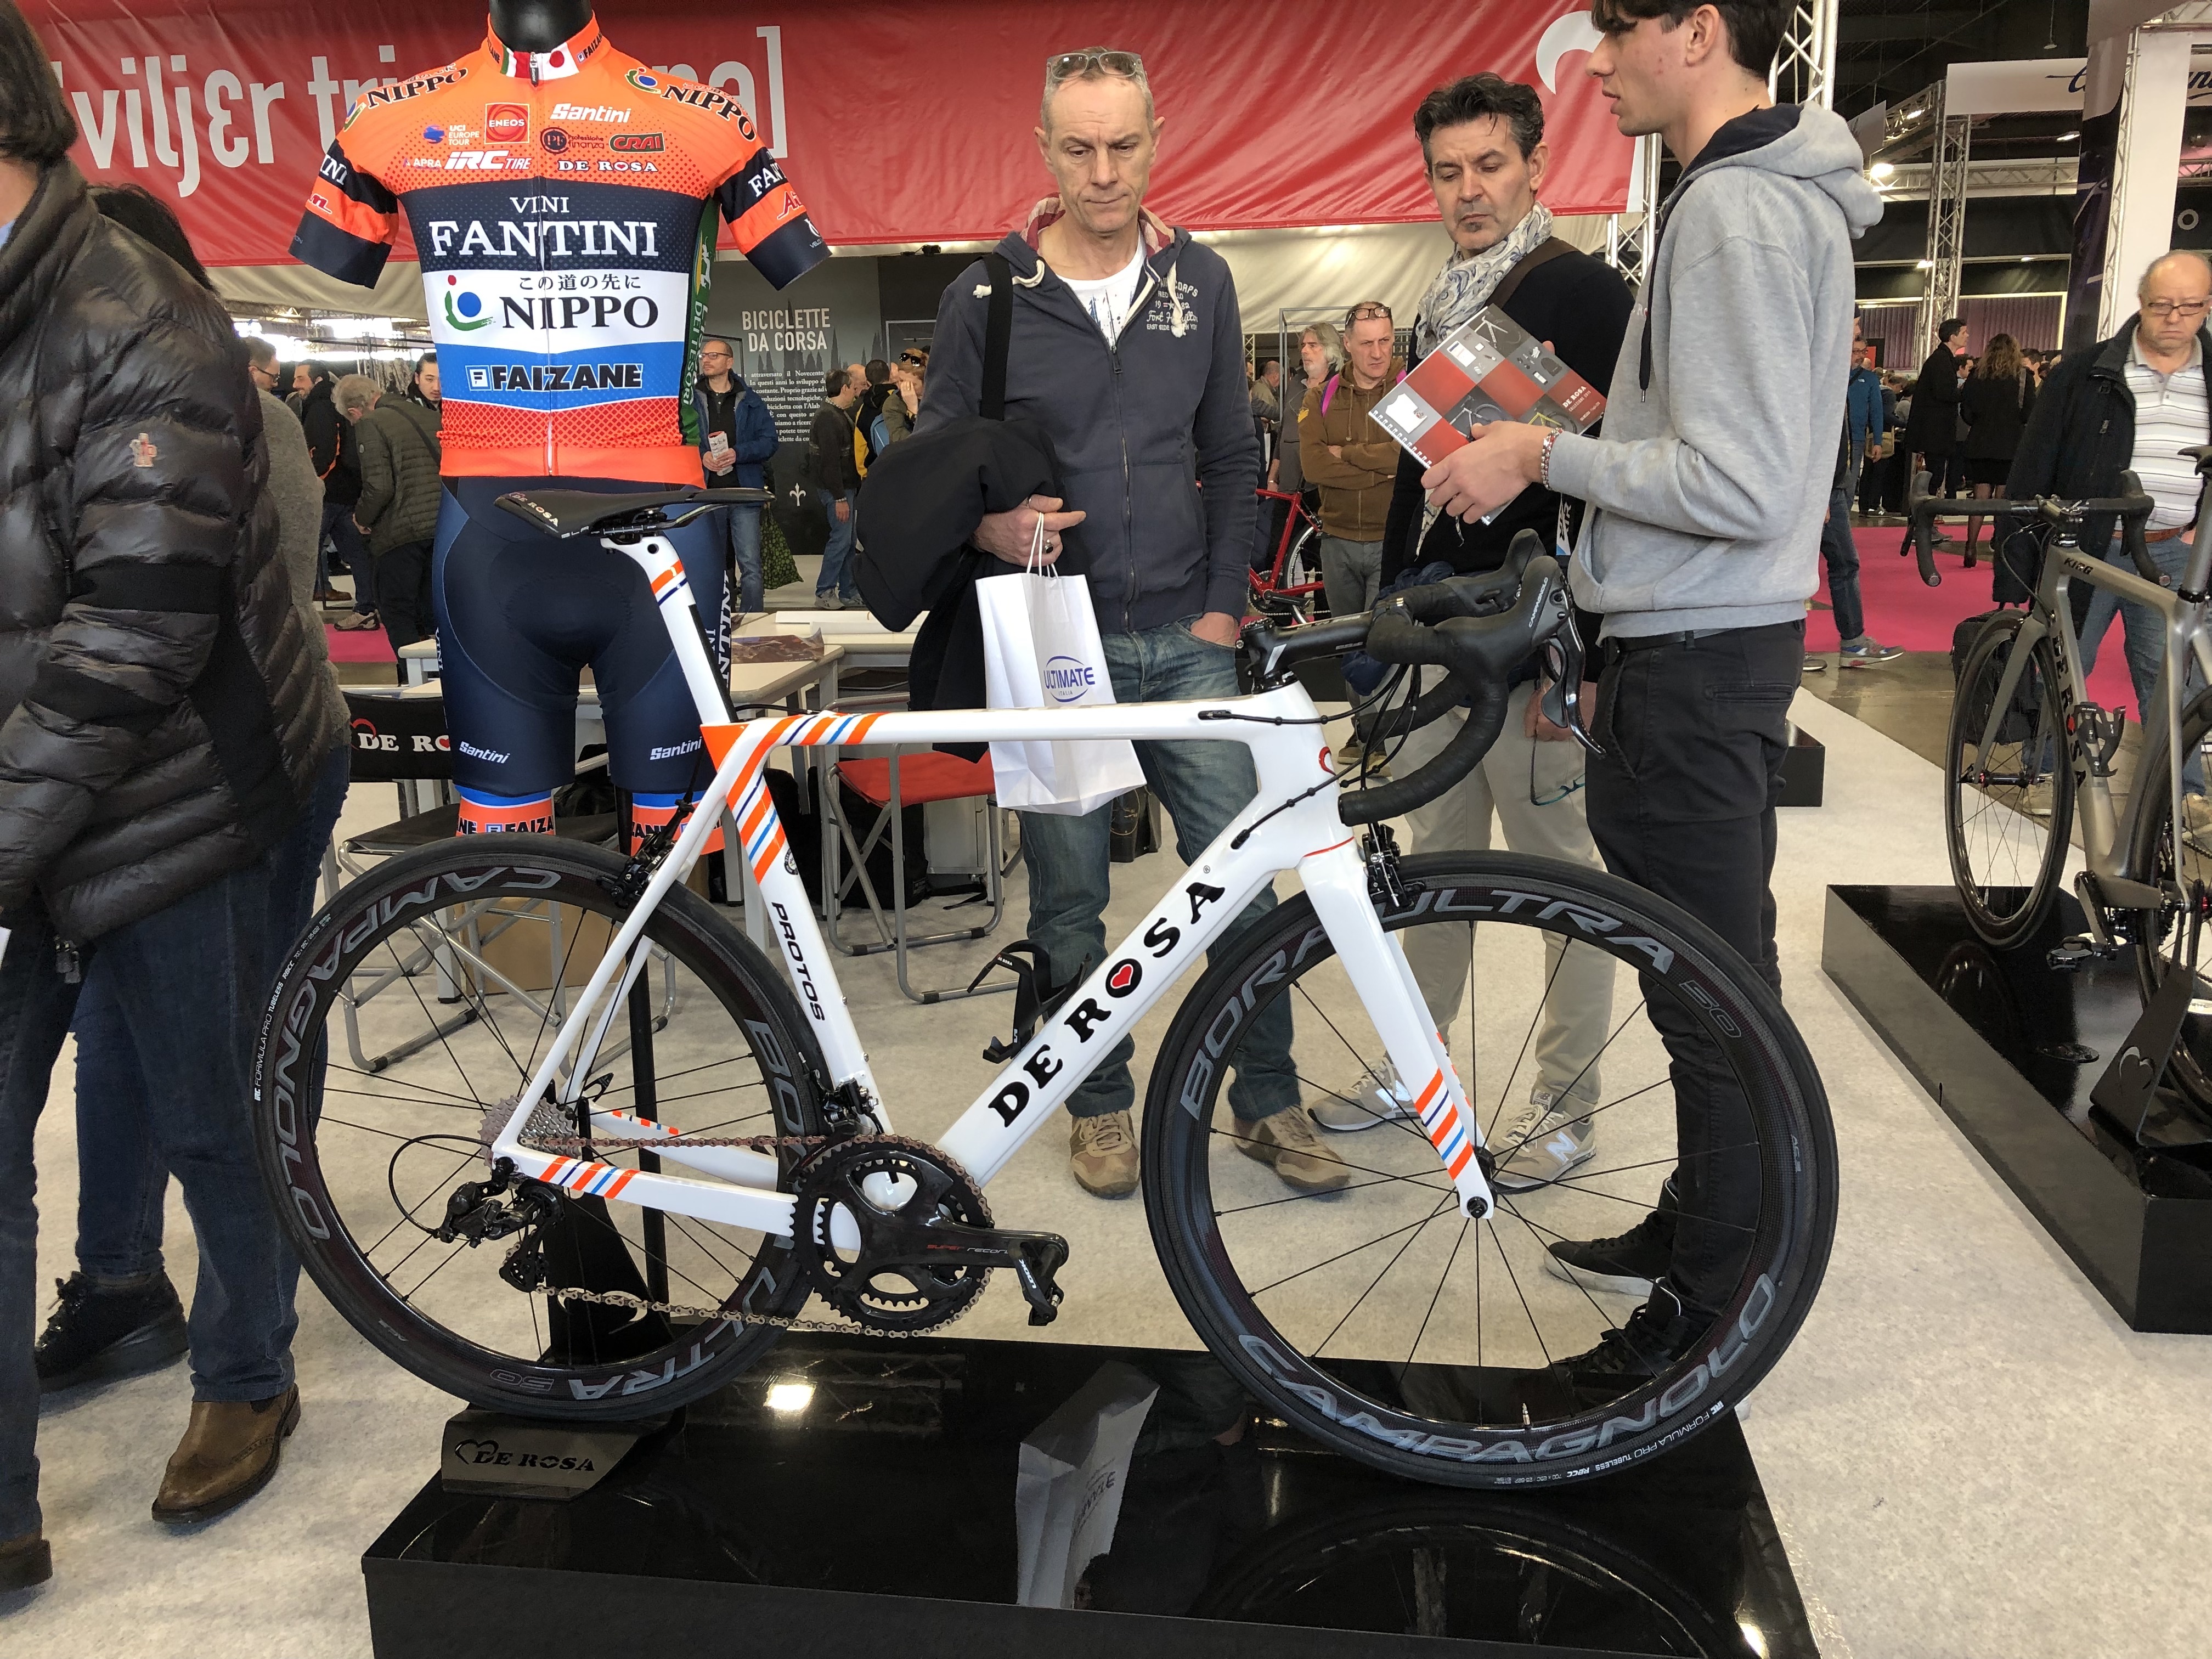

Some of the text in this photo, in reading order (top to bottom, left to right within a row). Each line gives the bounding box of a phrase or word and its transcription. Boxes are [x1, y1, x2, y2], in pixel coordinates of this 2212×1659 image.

[368, 67, 468, 109] NIPPO
[489, 119, 525, 127] ENEOS
[550, 103, 631, 123] Santini
[661, 84, 757, 142] NIPPO
[613, 136, 661, 150] CRAI
[413, 158, 442, 168] APRA
[505, 158, 532, 170] TIRE
[558, 160, 659, 172] DE ROSA
[510, 195, 569, 213] VINI
[429, 220, 659, 257] FANTINI
[519, 273, 642, 291] この道の先に
[499, 296, 659, 330] NIPPO
[1155, 300, 1161, 309] 19
[742, 308, 831, 330] BICICLETTE
[748, 330, 827, 352] DA CORSA
[683, 301, 703, 405] DEI TESORI
[1562, 386, 1587, 408] DE ROSA
[512, 494, 558, 527] DE ROSA
[1528, 577, 1549, 628] CAMPAGNOLO
[1043, 667, 1096, 690] ULTIMATE
[357, 732, 400, 752] DE
[459, 741, 511, 764] Santini
[649, 736, 703, 761] Santini
[770, 901, 826, 1022] PROTOS
[988, 882, 1226, 1128] DE ROSA
[255, 1037, 267, 1087] FORMULA
[262, 1013, 272, 1036] PRO
[268, 981, 284, 1012] TUBELESS
[281, 960, 295, 980] RBCC
[293, 950, 301, 960] 700
[273, 867, 561, 1242] CAMPAGNOLO
[1019, 1259, 1037, 1289] LOOK
[568, 1266, 777, 1401] ULTRA
[1238, 1273, 1776, 1464] CAMPAGNOLO
[1657, 1410, 1711, 1447] FORMULA
[472, 1448, 595, 1472] DE ROSA
[1634, 1440, 1658, 1459] PRO
[1566, 1466, 1590, 1478] RBCC
[1595, 1454, 1632, 1472] TUBELESS
